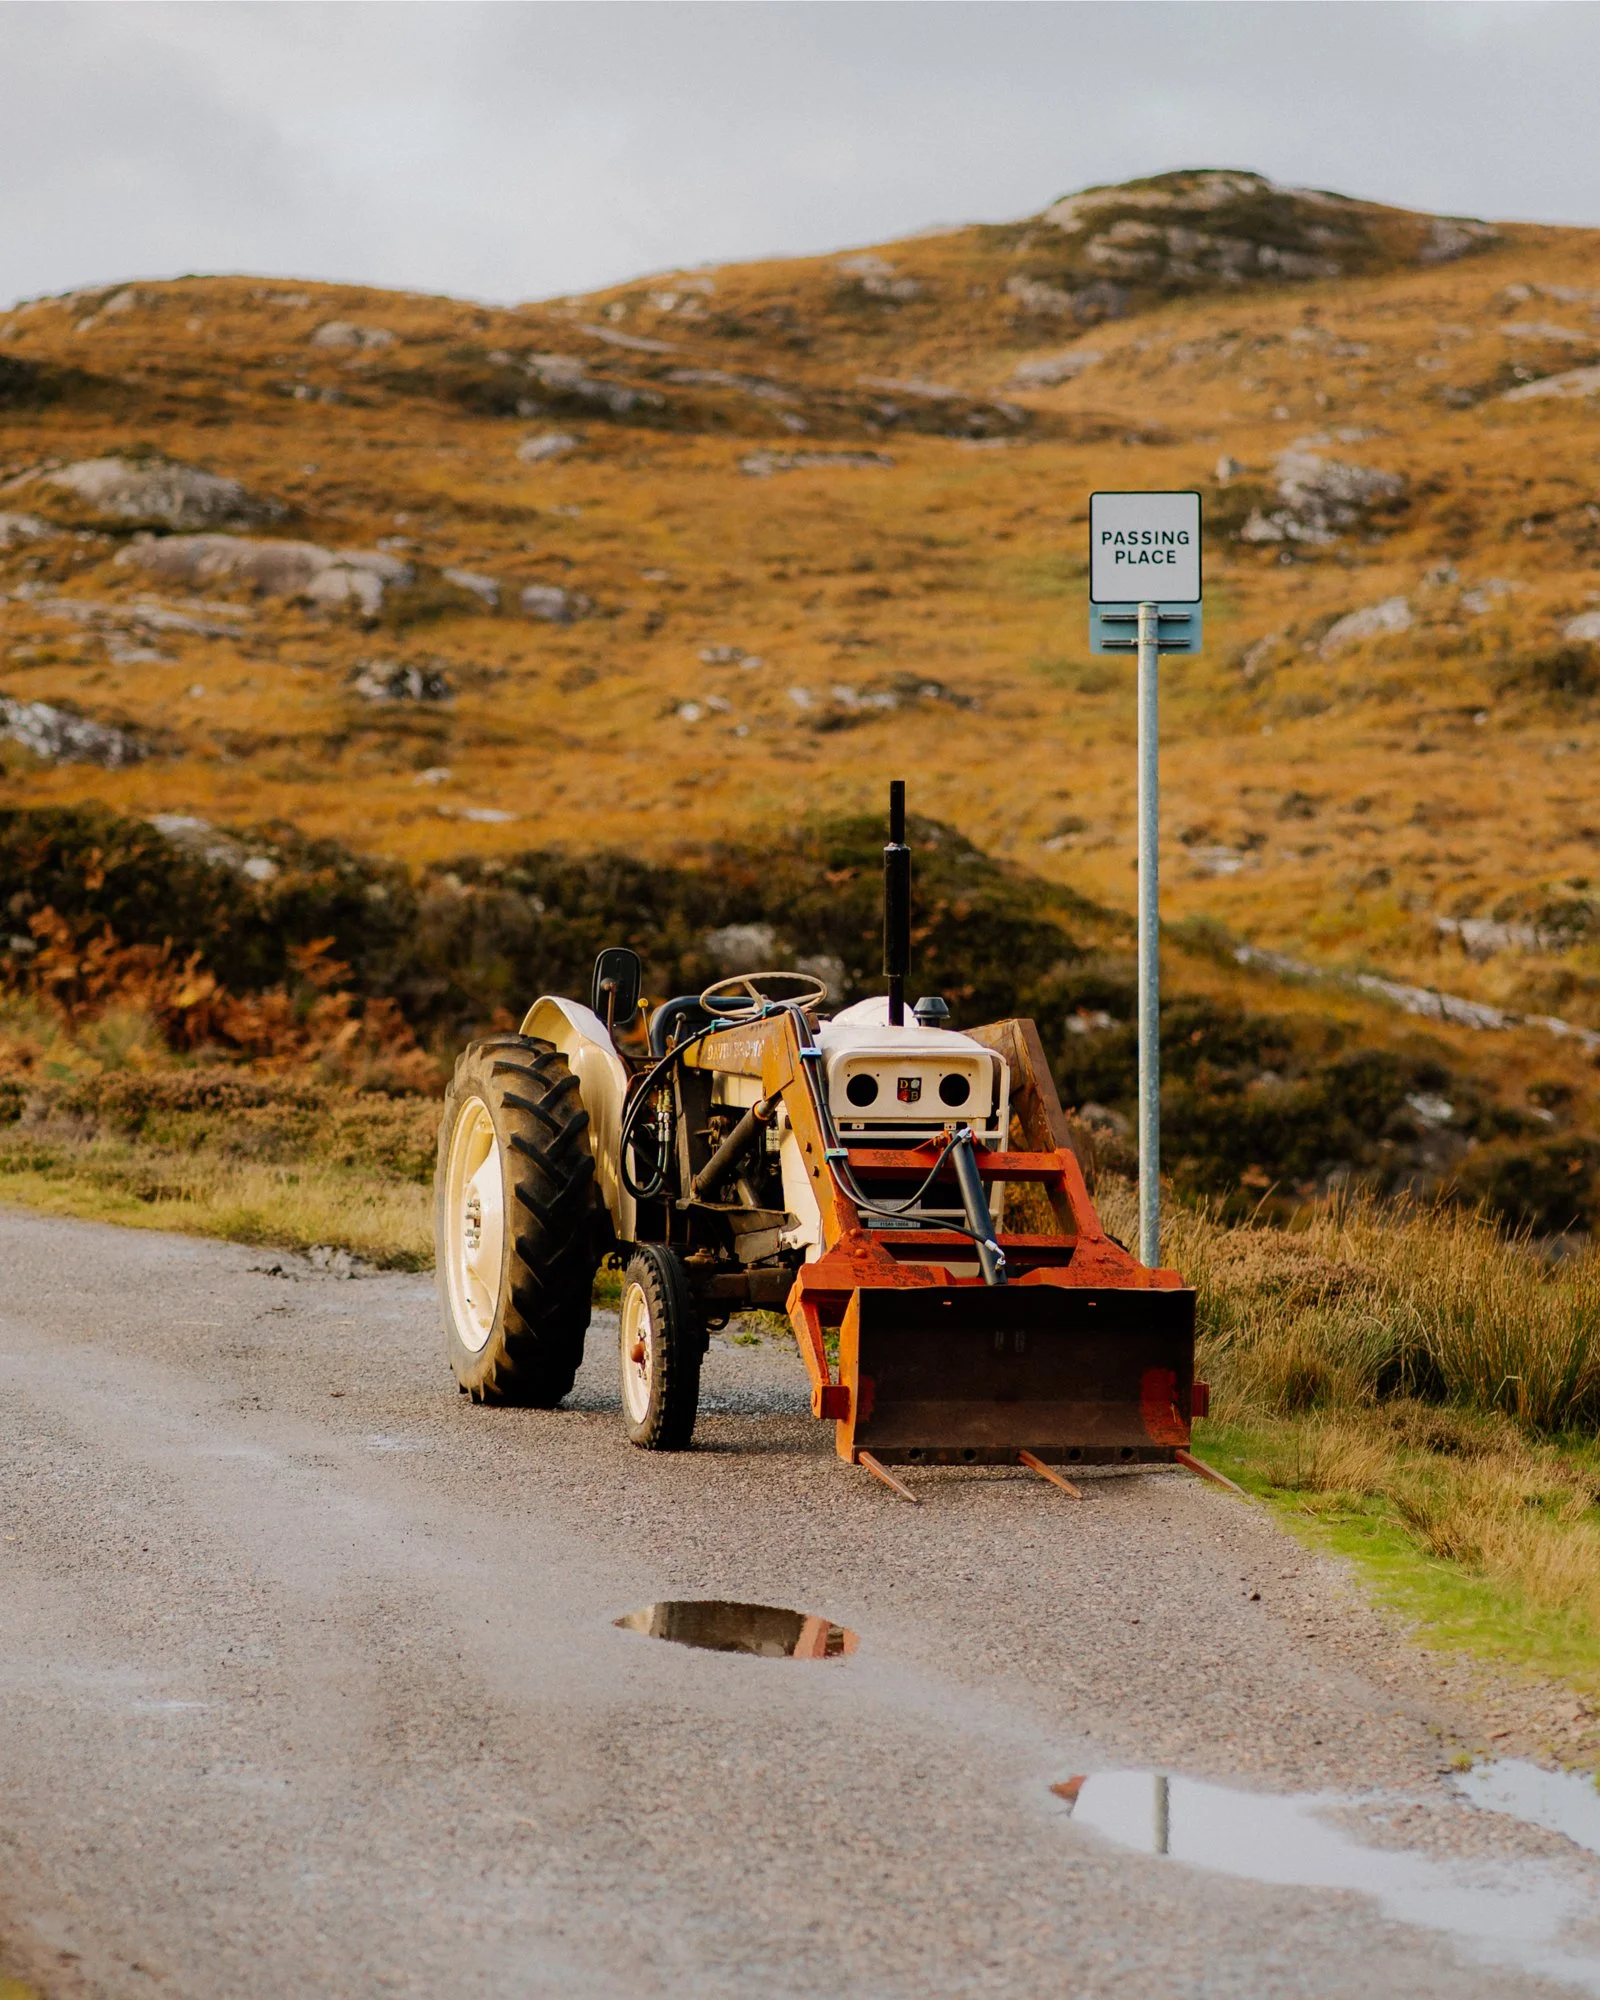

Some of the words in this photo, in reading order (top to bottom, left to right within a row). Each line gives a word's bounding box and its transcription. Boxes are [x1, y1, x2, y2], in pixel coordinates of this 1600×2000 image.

[1101, 531, 1190, 545] PASSING
[1115, 550, 1177, 564] PLACE
[900, 1080, 909, 1089] D
[911, 1091, 919, 1101] B
